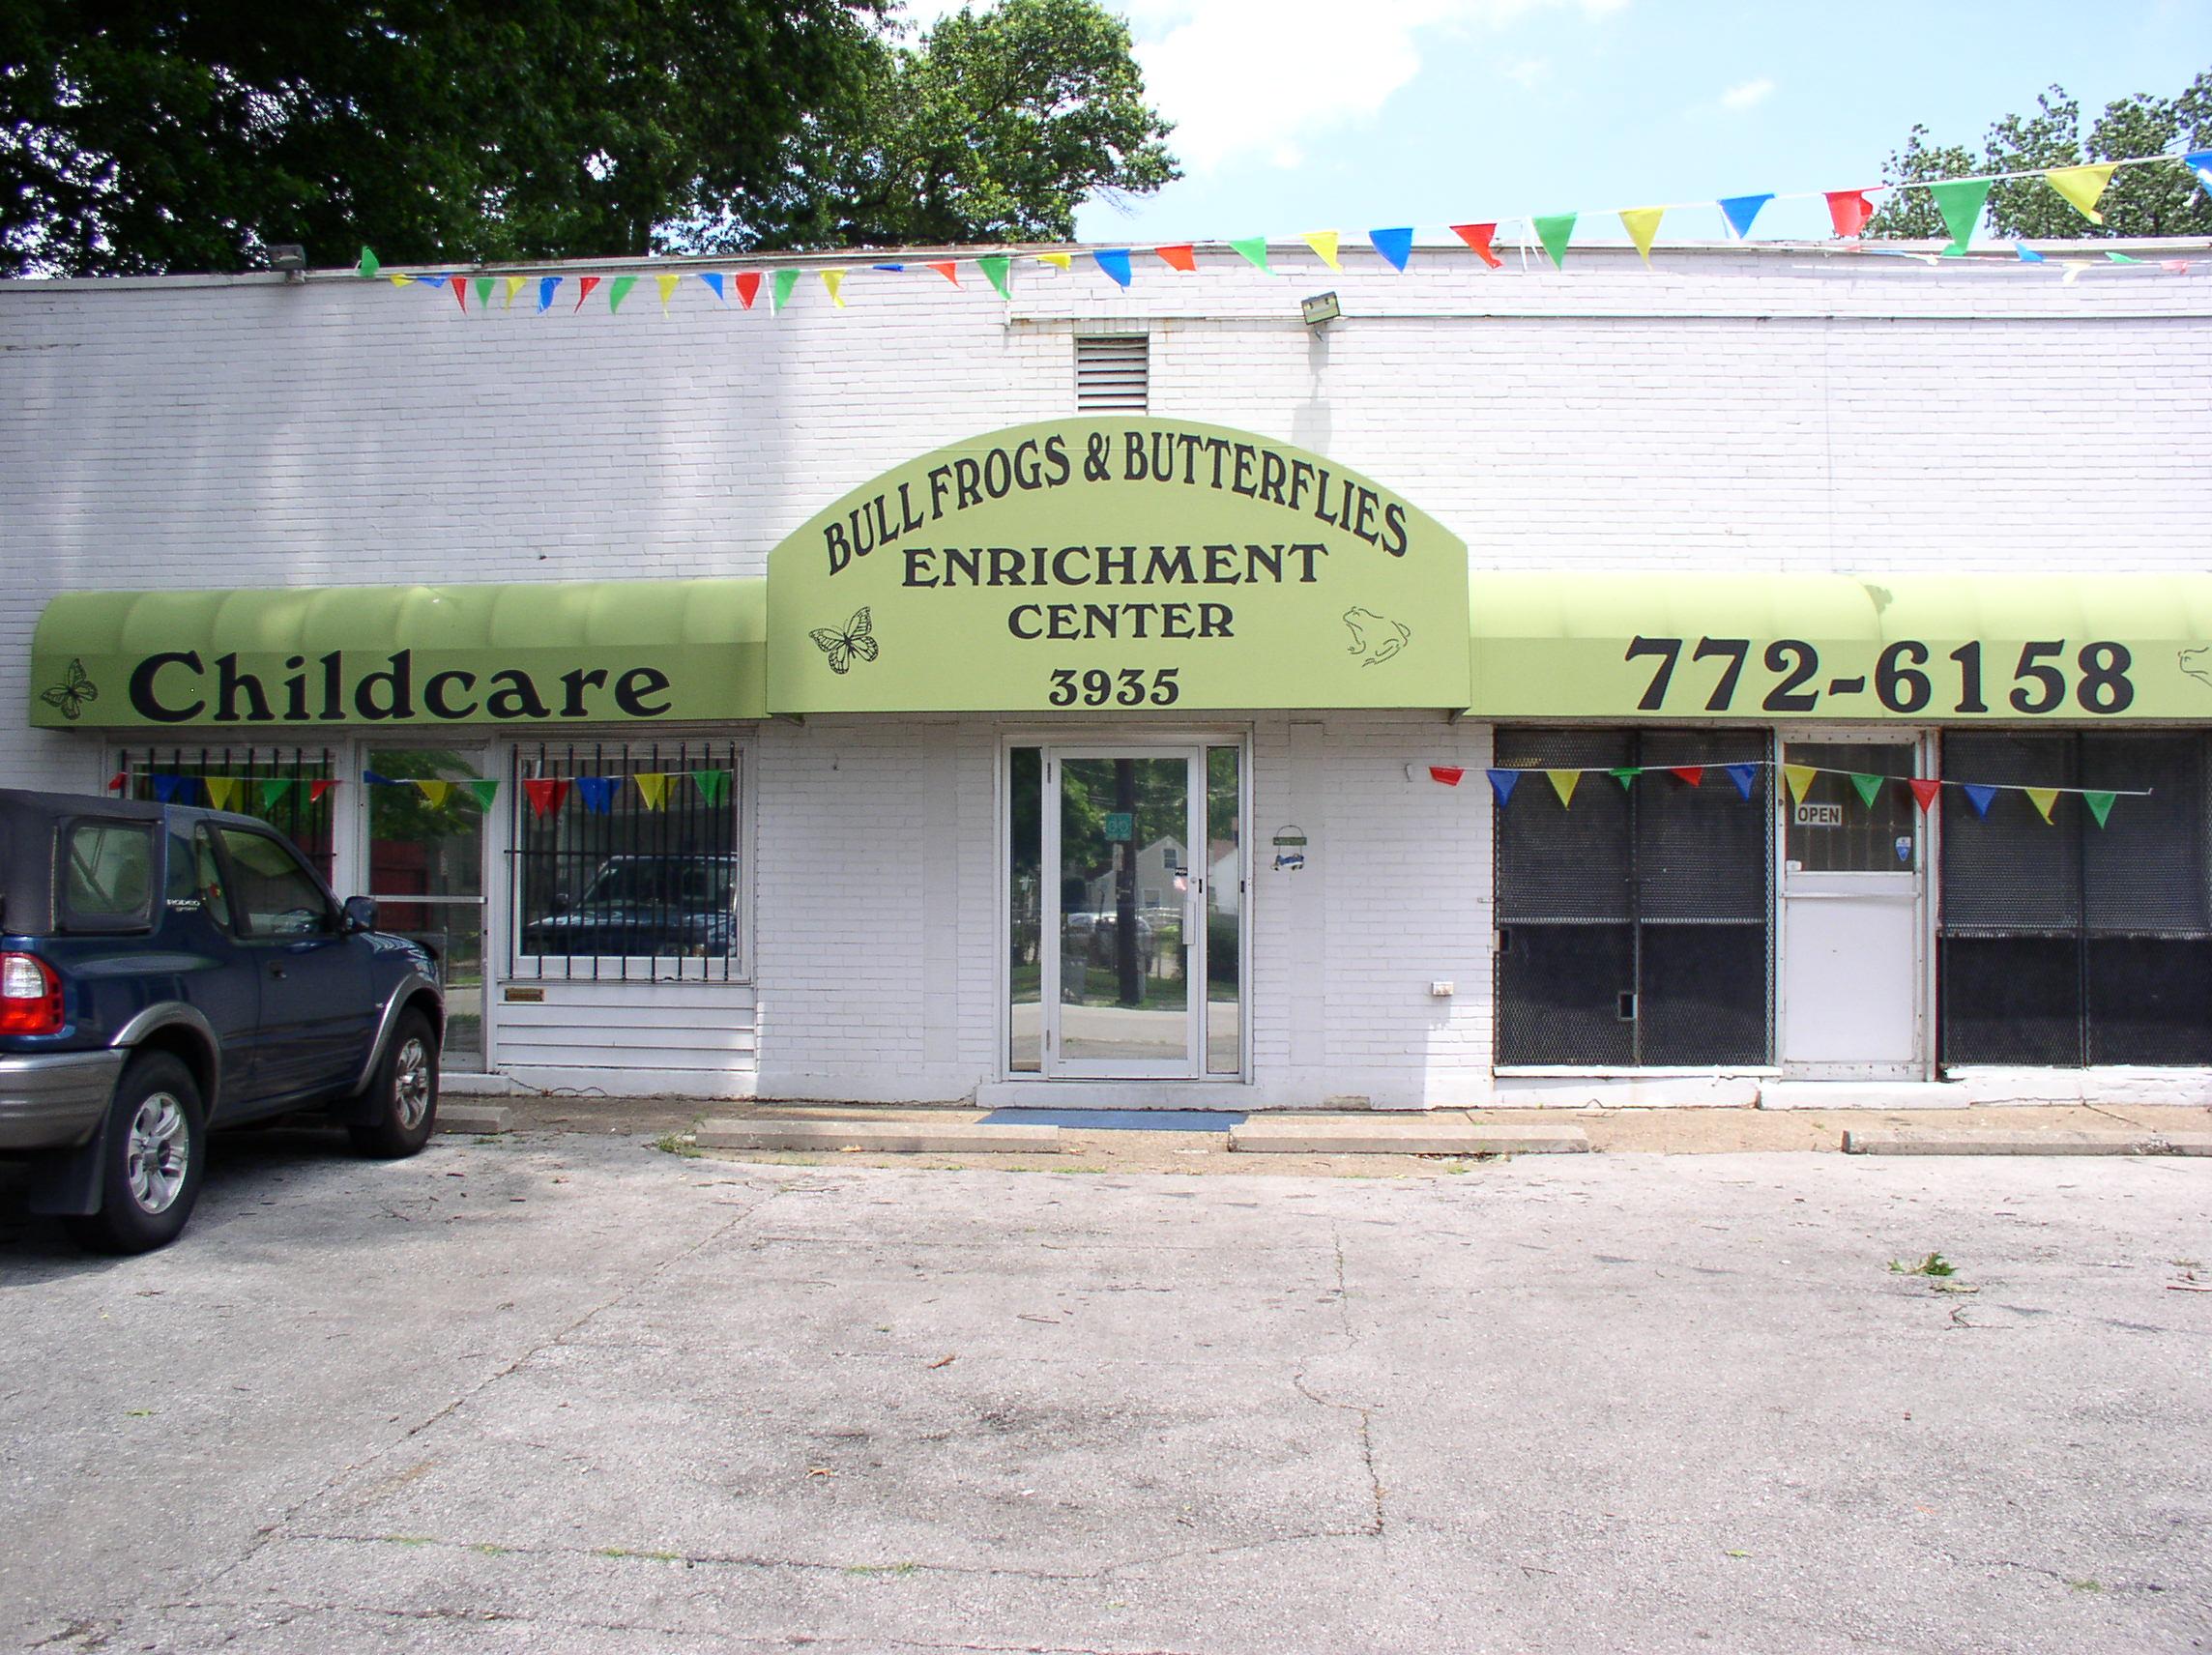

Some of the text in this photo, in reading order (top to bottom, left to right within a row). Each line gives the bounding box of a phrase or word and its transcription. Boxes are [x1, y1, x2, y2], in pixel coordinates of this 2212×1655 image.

[1084, 431, 1113, 482] &
[1123, 430, 1409, 559] BUTTERFLIES
[901, 543, 1329, 589] ENRICHMENT
[1006, 602, 1236, 641] CENTER
[129, 648, 674, 723] Childcare
[1047, 667, 1180, 707] 3935
[1624, 635, 2136, 714] 772-6158
[1797, 806, 1840, 823] OPEN
